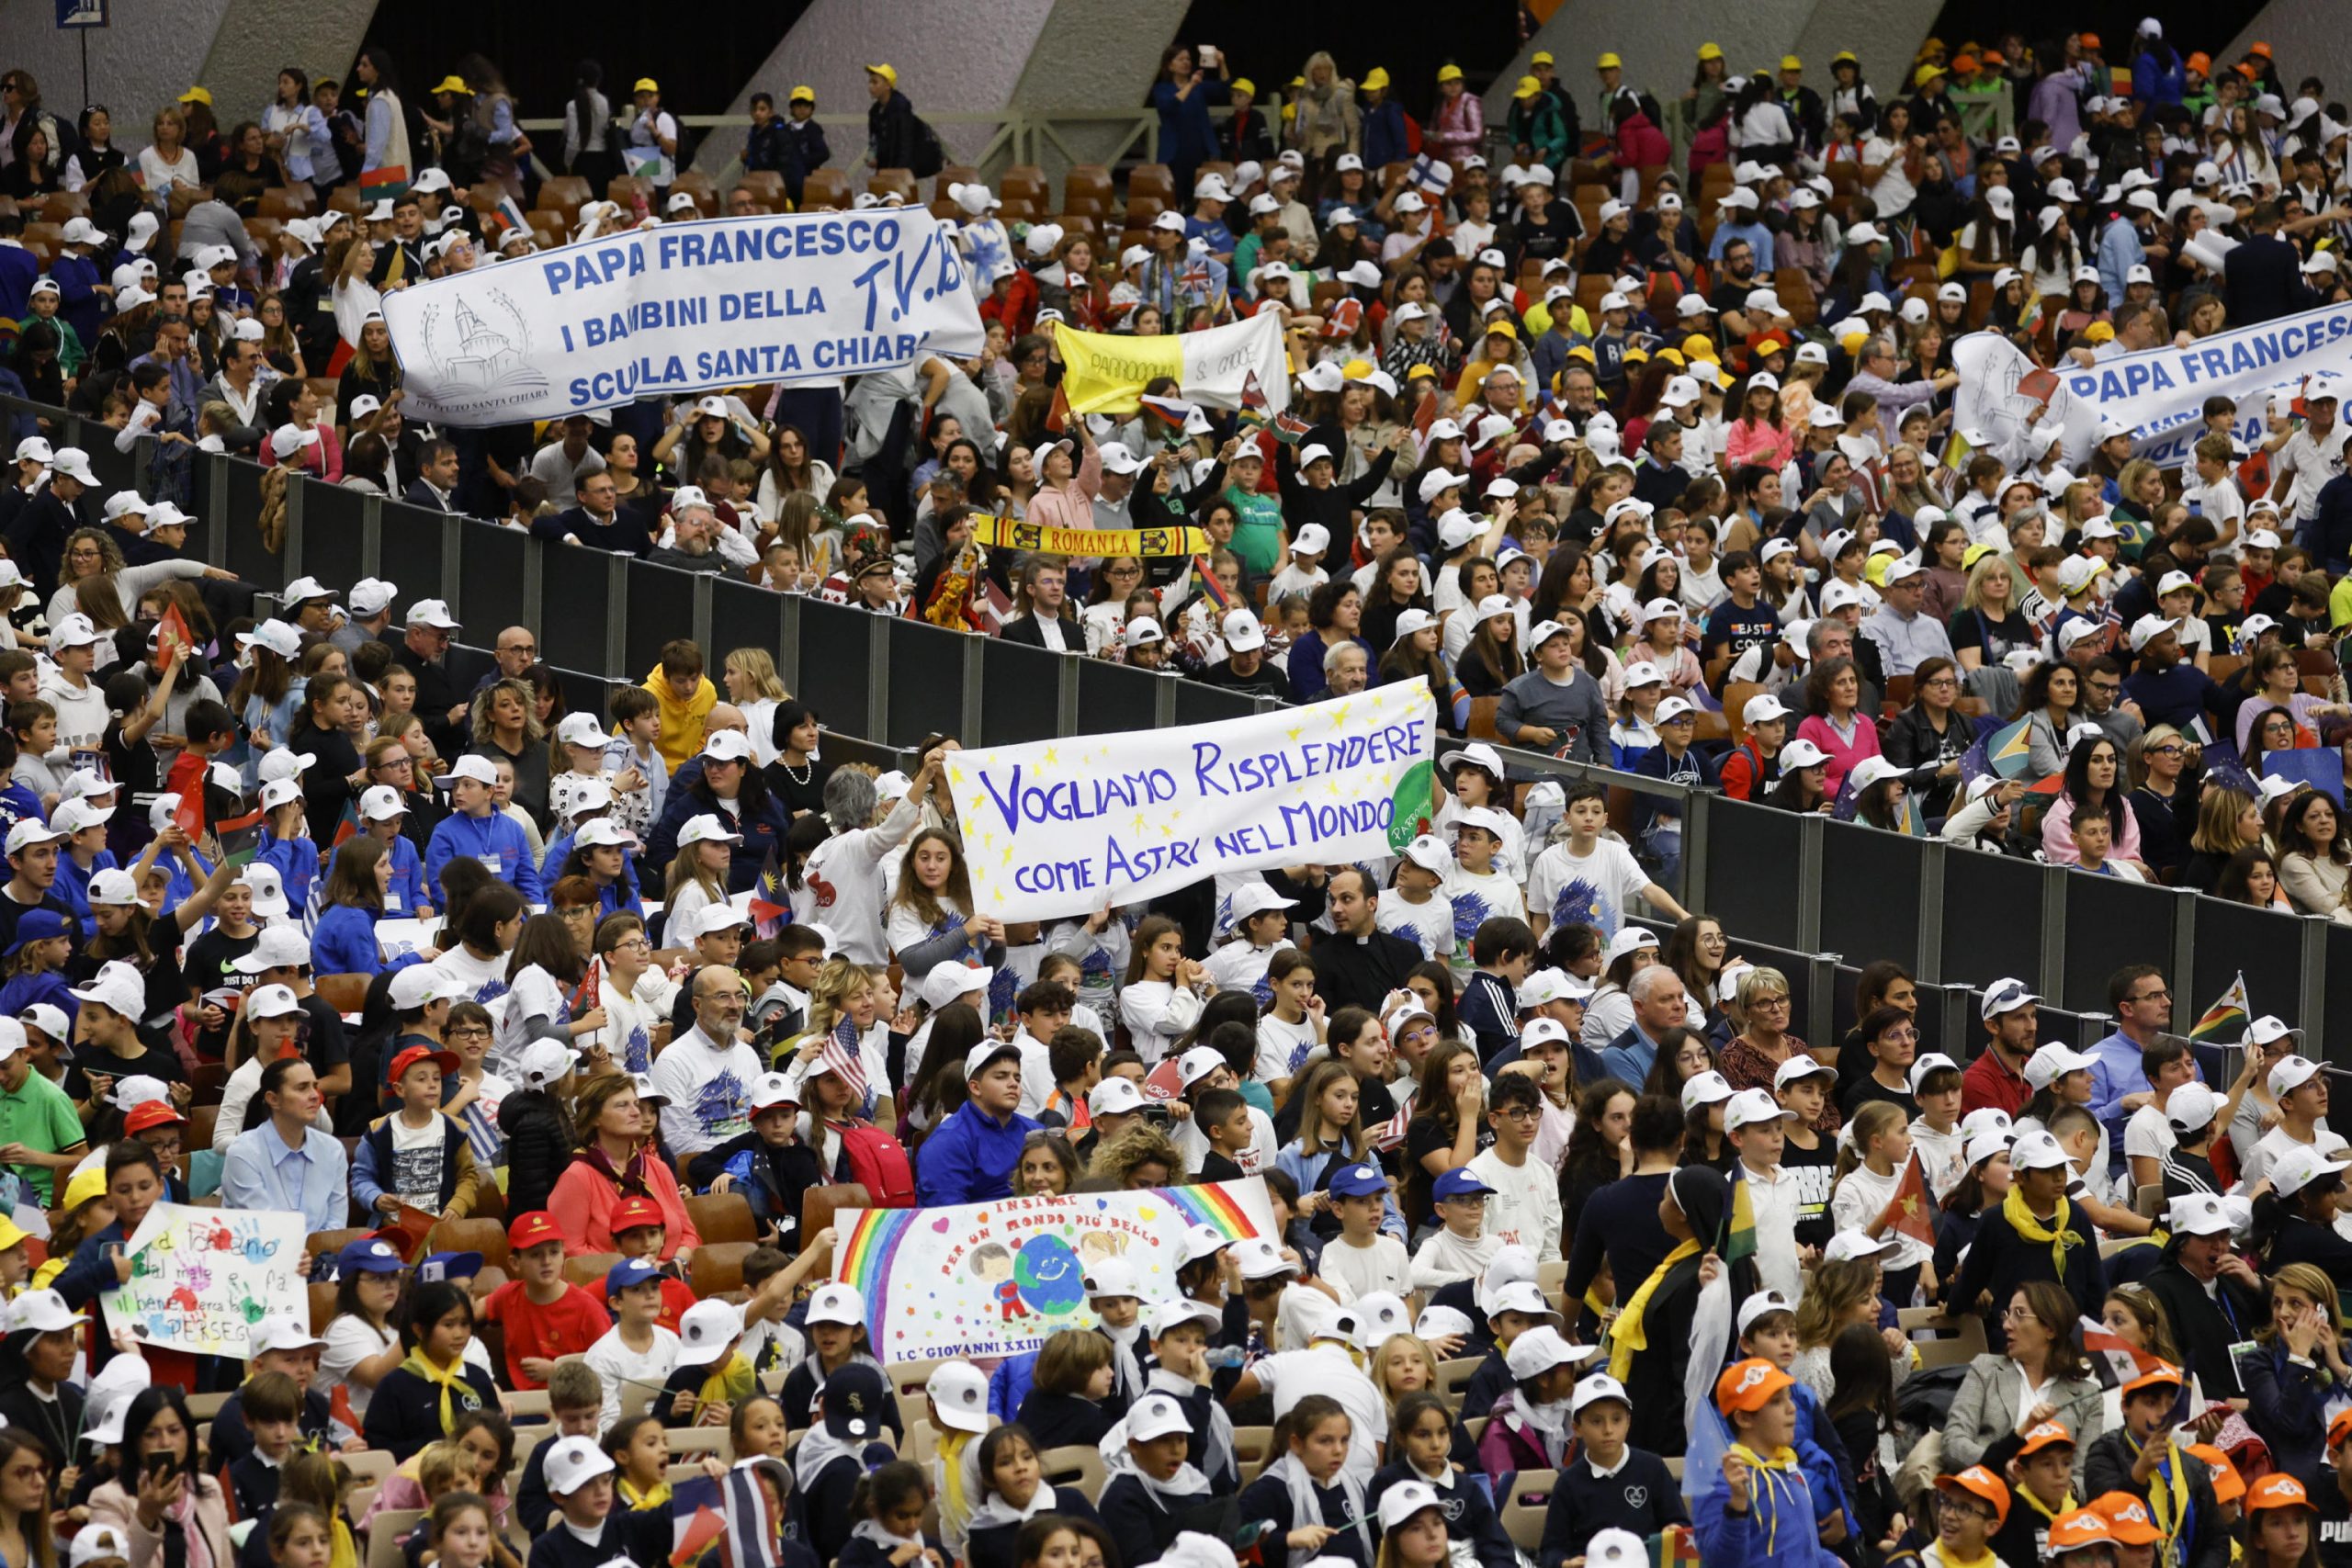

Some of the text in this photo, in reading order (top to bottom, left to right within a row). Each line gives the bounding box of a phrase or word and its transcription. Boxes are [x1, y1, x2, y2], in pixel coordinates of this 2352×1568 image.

[543, 219, 900, 295] PAPA FRANCESCO
[560, 325, 574, 353] I
[719, 287, 826, 321] DELLA
[696, 344, 802, 380] SANTA
[2069, 361, 2176, 403] PAPA
[2180, 315, 2352, 383] FRANCES
[416, 389, 549, 412] ISTITUTO SANTA CHIARA
[1050, 531, 1130, 554] ROMANIA
[978, 719, 1425, 835] VOGLIAMO RISPLENDERE
[1015, 858, 1095, 894] COME
[1215, 824, 1284, 858] NEL
[1278, 796, 1396, 847] MONDO
[223, 976, 240, 986] JUST
[241, 976, 254, 985] DO
[941, 1245, 965, 1277] PER
[969, 1227, 990, 1245] UN
[1006, 1213, 1066, 1232] MONDO
[1110, 1217, 1160, 1247] BELLO
